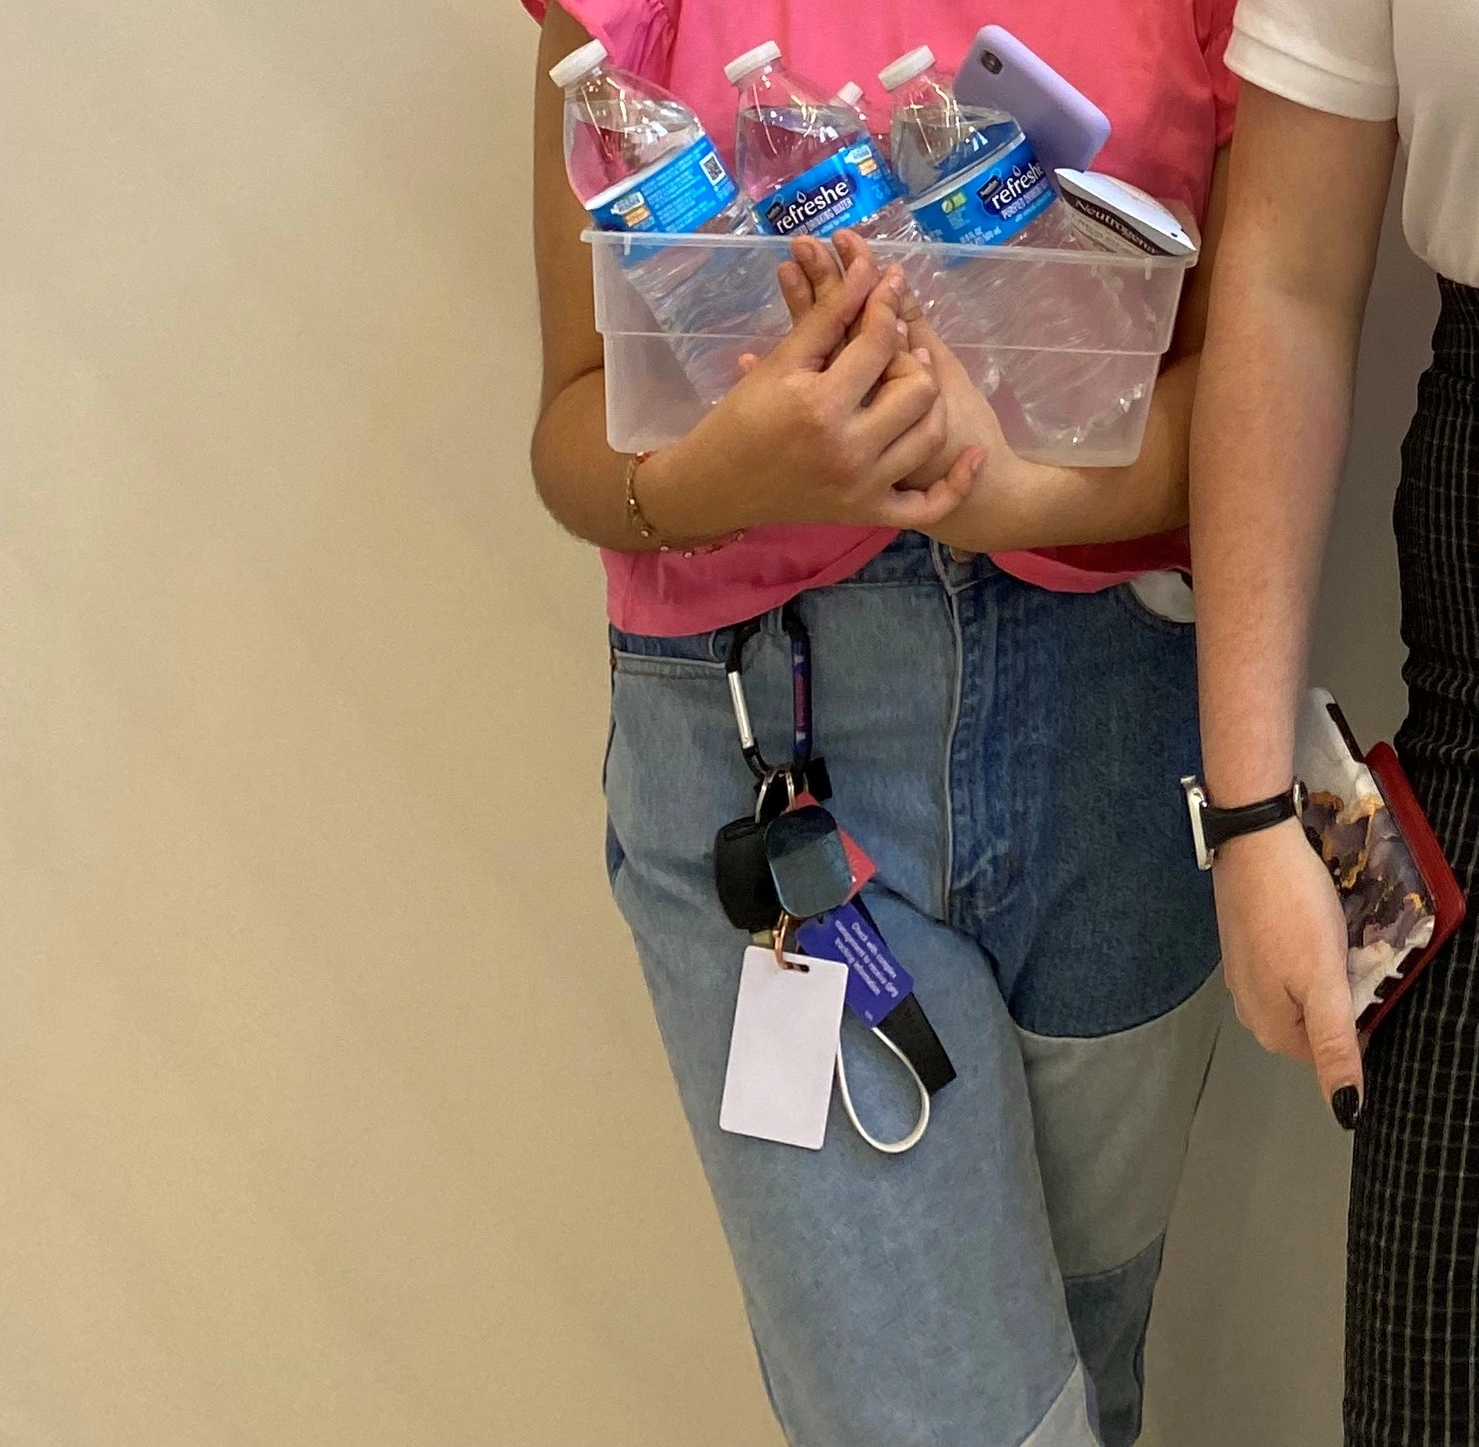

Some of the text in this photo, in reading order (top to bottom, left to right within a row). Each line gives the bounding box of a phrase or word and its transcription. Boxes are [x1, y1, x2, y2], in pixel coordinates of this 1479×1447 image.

[776, 181, 849, 234] refreshe
[1075, 197, 1156, 254] Neutrogena
[885, 982, 899, 998] GPS
